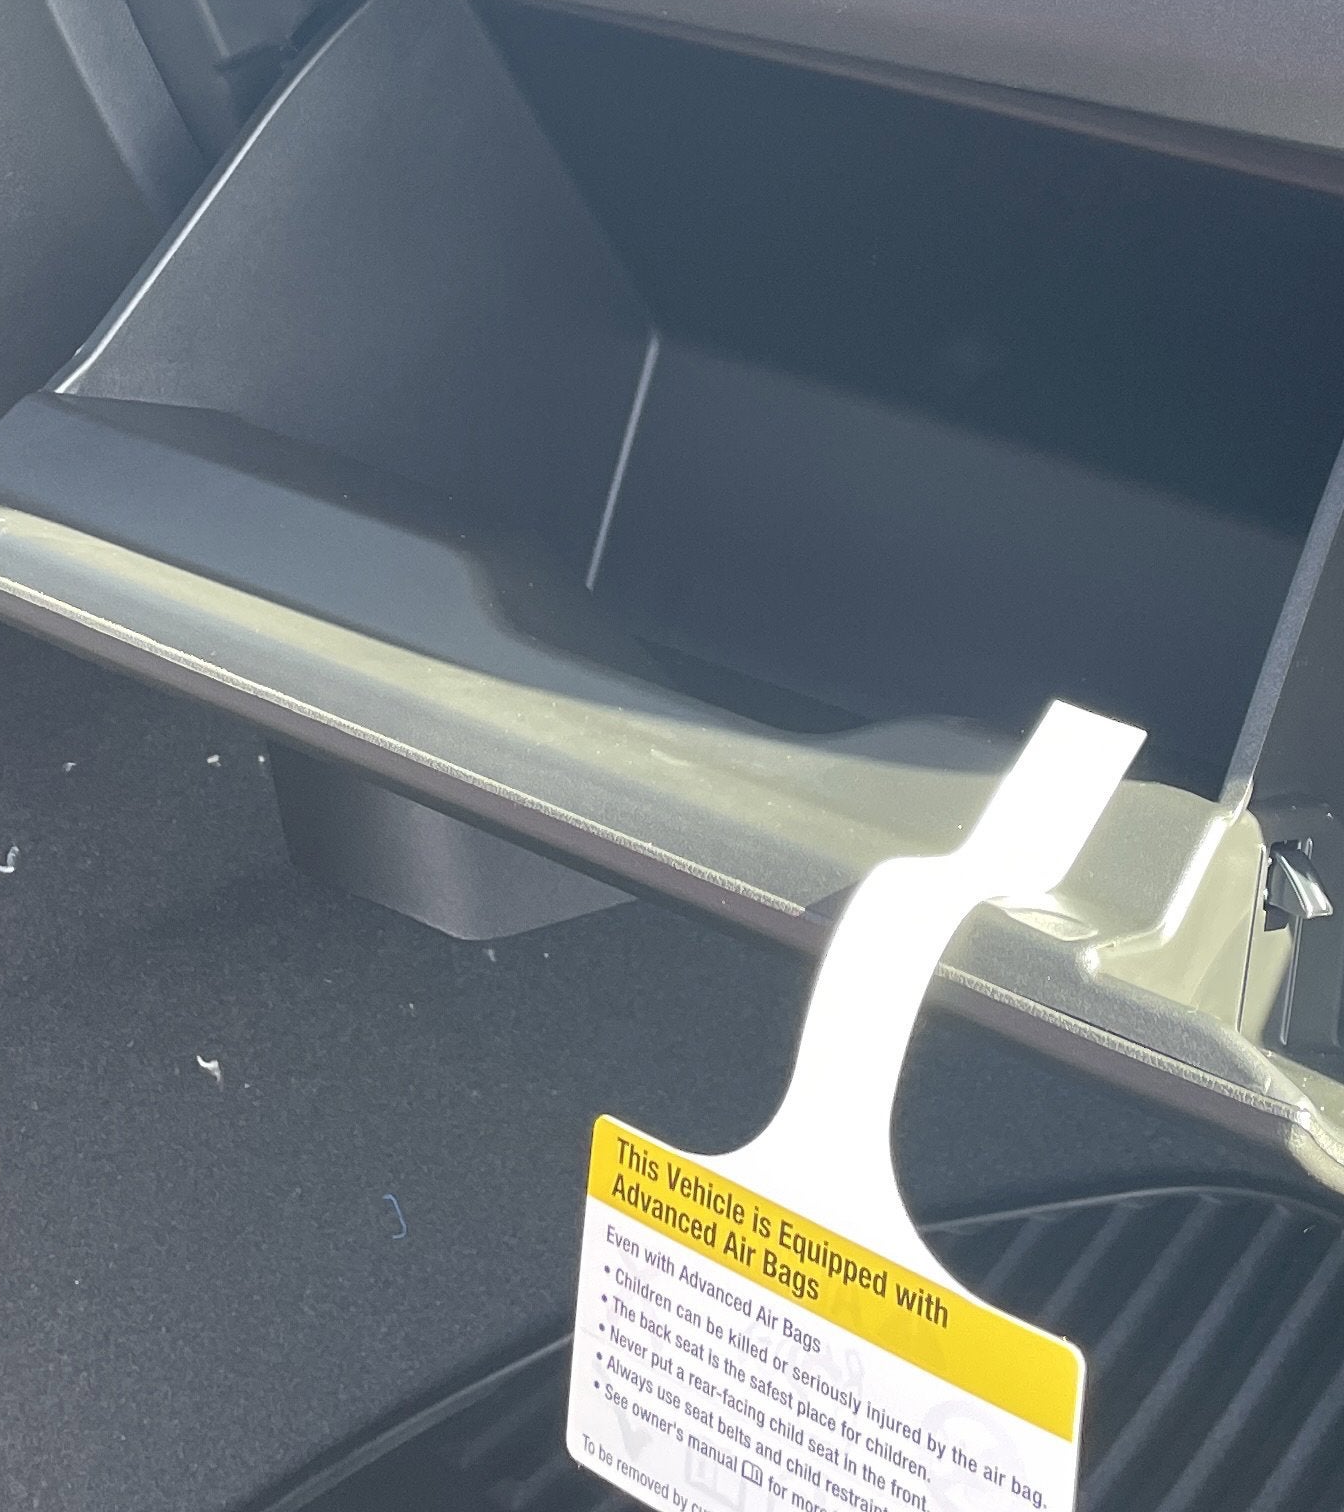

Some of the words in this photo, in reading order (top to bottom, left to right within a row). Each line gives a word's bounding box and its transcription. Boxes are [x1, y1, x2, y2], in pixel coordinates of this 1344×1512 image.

[606, 1224, 640, 1258] Even
[644, 1249, 675, 1277] with
[678, 1264, 752, 1318] Advanced
[755, 1305, 779, 1330] Air
[782, 1317, 821, 1353] Bags
[611, 1173, 718, 1248] Advanced
[723, 1231, 756, 1267] Air
[762, 1248, 819, 1300] Bags
[617, 1136, 659, 1182] This
[667, 1162, 745, 1225] Vehicle
[752, 1205, 771, 1239] is
[778, 1219, 888, 1298] Equipped
[895, 1283, 948, 1329] with
[604, 1383, 628, 1410] See
[632, 1403, 684, 1442] owner's
[687, 1433, 738, 1473] manual
[768, 1475, 788, 1500] for
[606, 1355, 653, 1394] Always
[657, 1386, 681, 1409] use
[684, 1401, 714, 1429] seat
[717, 1416, 751, 1449] belts
[755, 1441, 782, 1466] and
[786, 1458, 821, 1487] child
[610, 1325, 648, 1360] Never
[651, 1352, 673, 1375] put
[676, 1366, 685, 1382] a
[688, 1372, 765, 1428] rear-facing
[769, 1417, 804, 1446] child
[808, 1438, 840, 1466] seat
[843, 1453, 857, 1476] in
[862, 1463, 886, 1490] the
[612, 1295, 636, 1323] The
[639, 1311, 672, 1343] back
[675, 1335, 705, 1361] seat
[708, 1349, 720, 1369] is
[724, 1358, 746, 1383] the
[749, 1375, 793, 1410] safest
[796, 1400, 836, 1432] place
[841, 1420, 862, 1444] for
[865, 1437, 931, 1484] children.
[615, 1268, 672, 1312] Children
[676, 1304, 701, 1328] can
[706, 1316, 724, 1340] be
[728, 1328, 768, 1364] killed
[772, 1356, 789, 1374] or
[792, 1366, 862, 1416] seriously
[866, 1402, 922, 1445] injured
[927, 1433, 946, 1460] by
[951, 1446, 978, 1473] the
[983, 1466, 1006, 1487] air
[1011, 1475, 1047, 1511] bag.
[582, 1433, 595, 1455] To
[598, 1445, 613, 1466] be
[616, 1459, 669, 1499] removed
[672, 1488, 688, 1512] by
